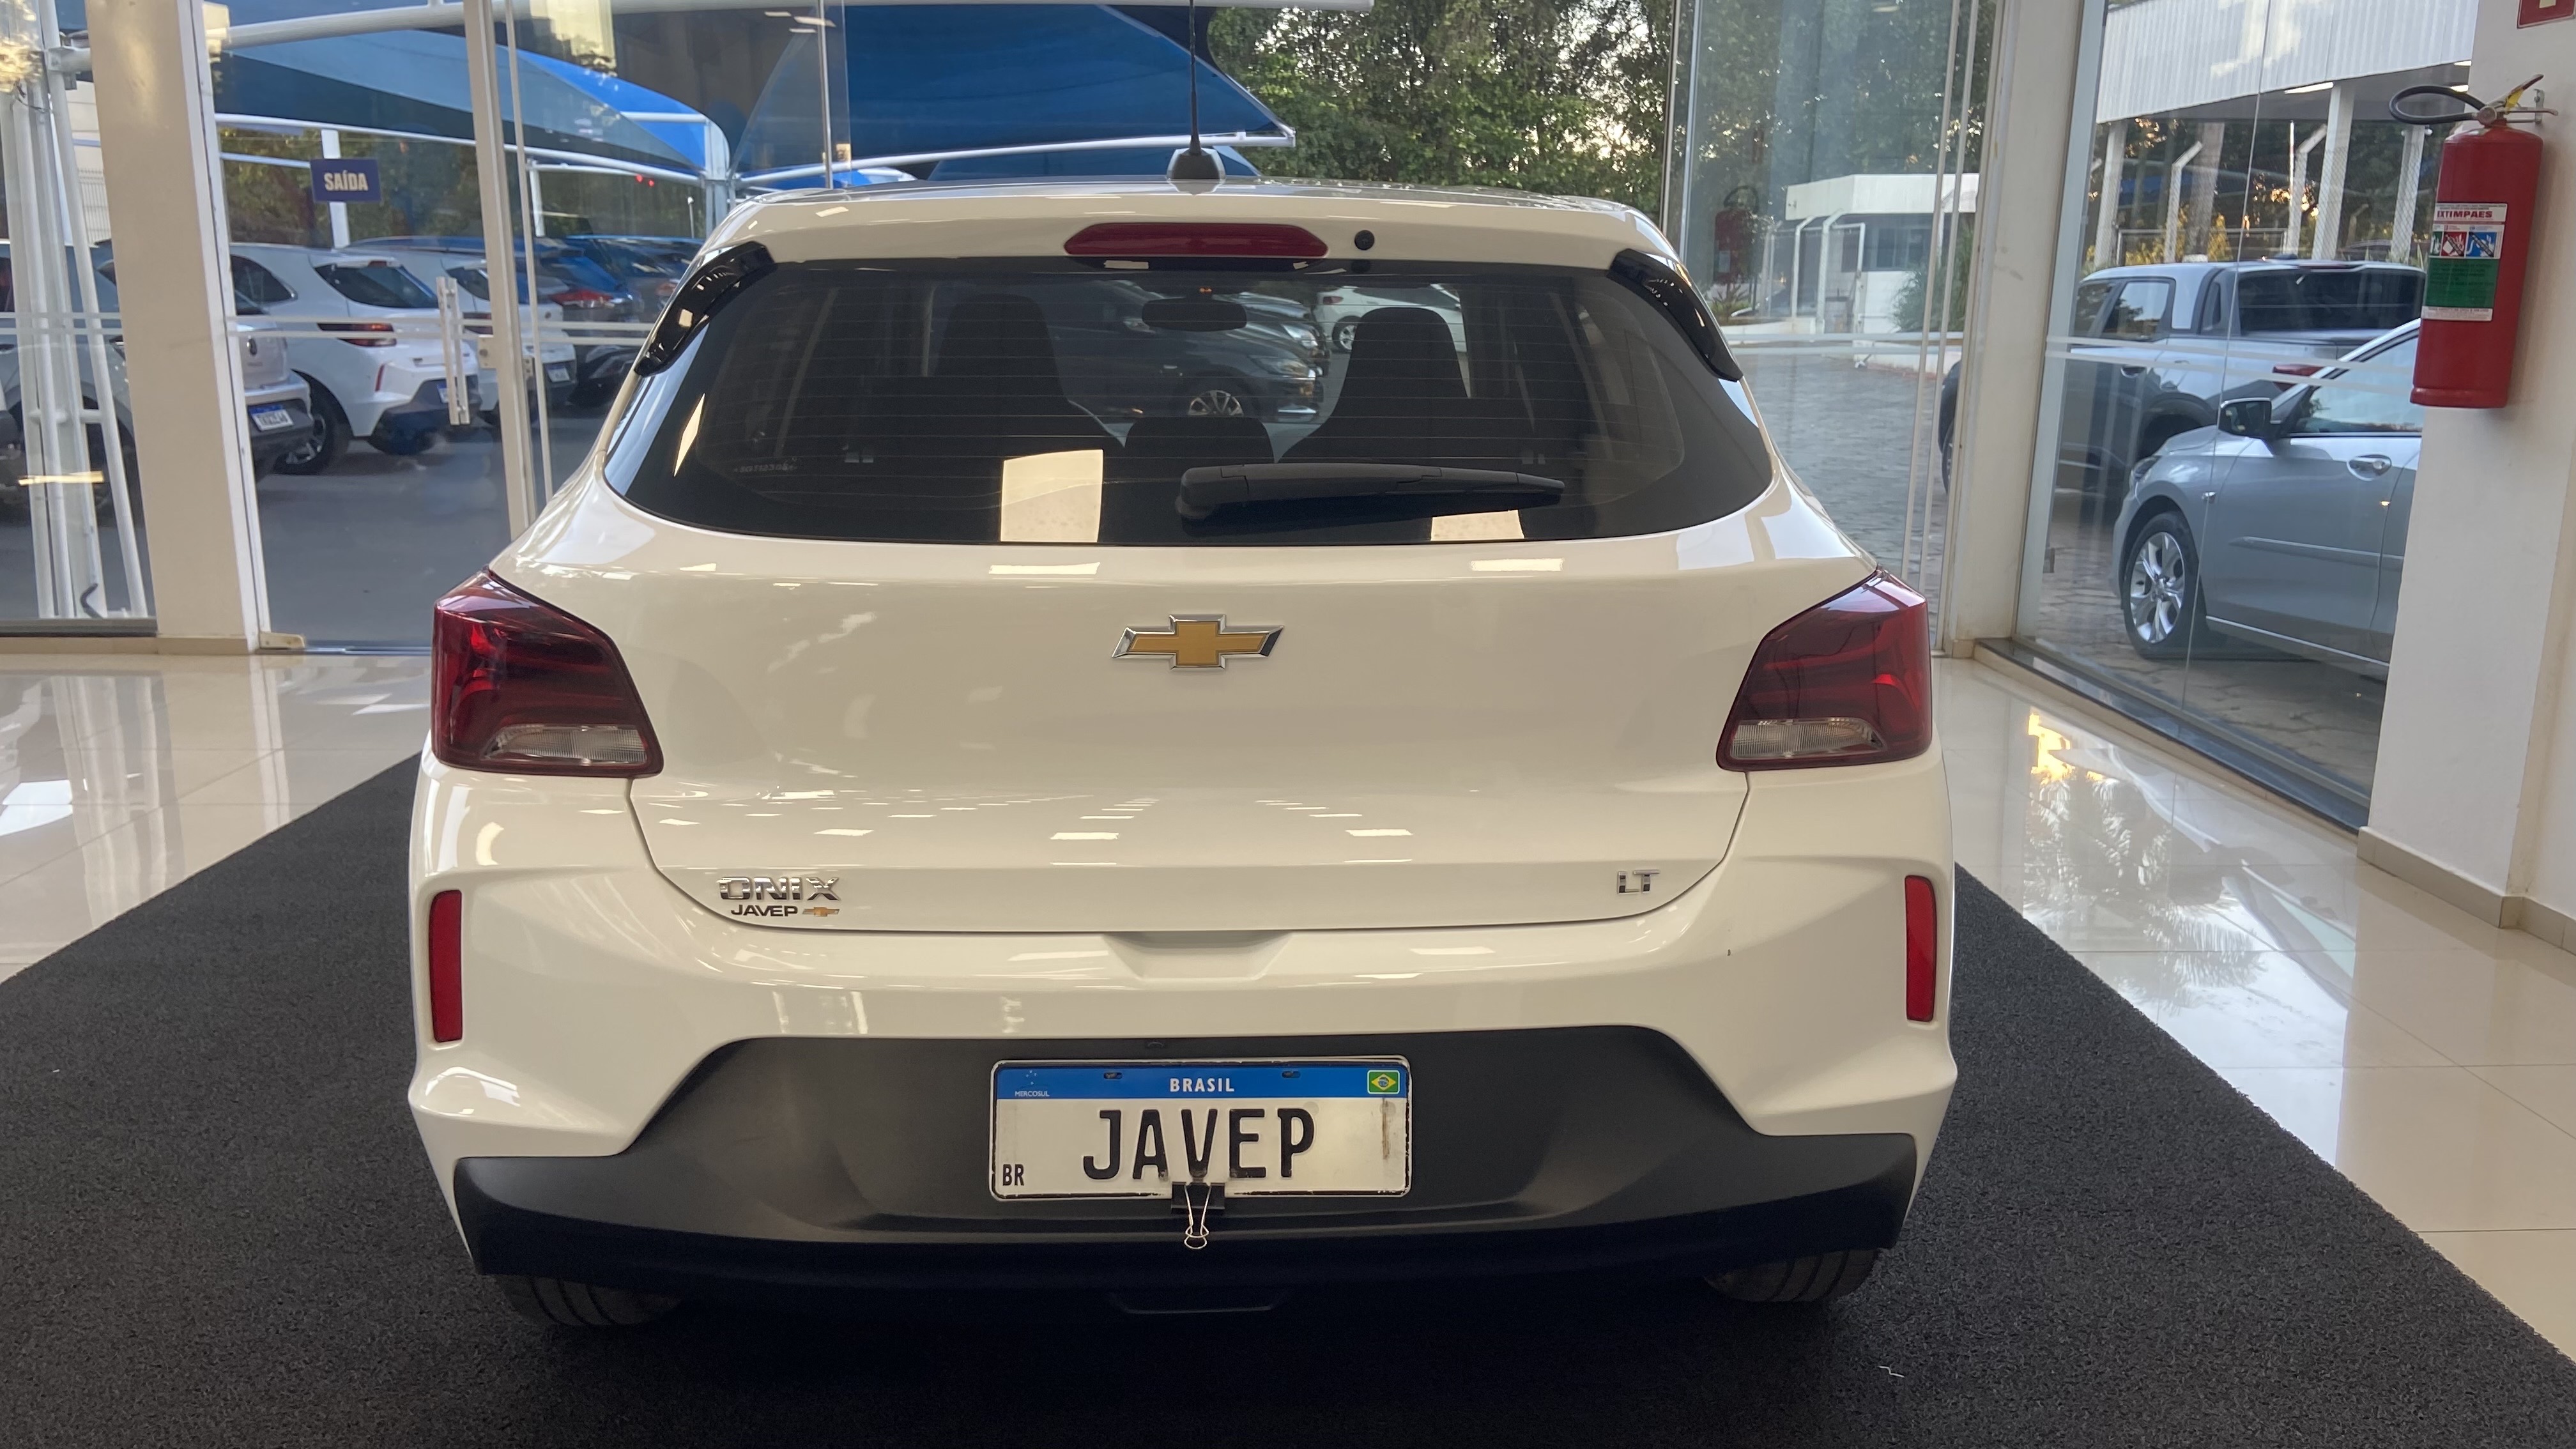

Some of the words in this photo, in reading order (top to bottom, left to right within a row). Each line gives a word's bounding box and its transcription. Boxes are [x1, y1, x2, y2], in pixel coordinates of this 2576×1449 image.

[324, 169, 369, 191] SAÍDA
[717, 877, 841, 901] ONIX
[1617, 869, 1660, 894] LT
[730, 904, 799, 917] JAVEP
[1169, 1078, 1235, 1093] BRASIL
[1083, 1108, 1315, 1180] JAVEP
[1002, 1163, 1025, 1186] BR
